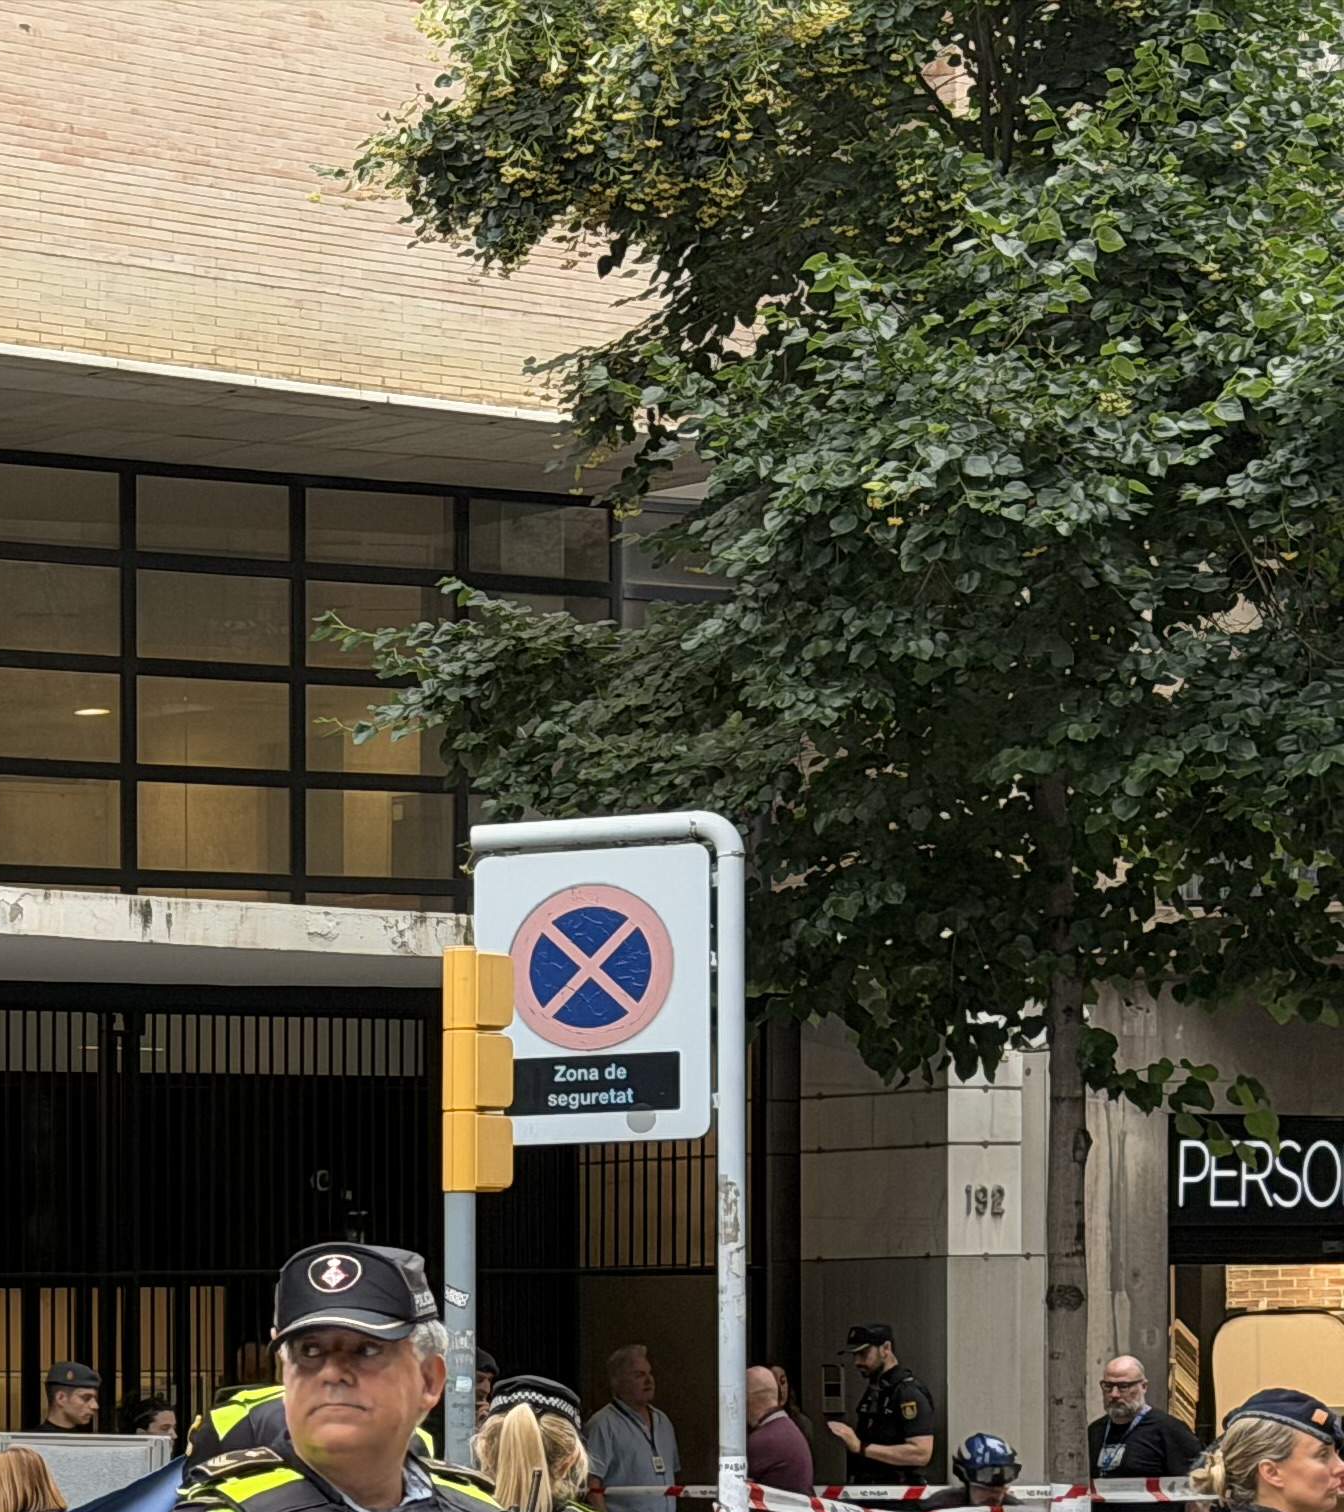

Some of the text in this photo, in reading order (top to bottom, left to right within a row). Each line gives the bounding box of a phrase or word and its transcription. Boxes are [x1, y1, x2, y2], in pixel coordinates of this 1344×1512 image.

[554, 1063, 628, 1082] Zona de
[547, 1088, 634, 1110] seguretat
[1177, 1139, 1344, 1208] PERSO
[964, 1184, 1005, 1217] 192
